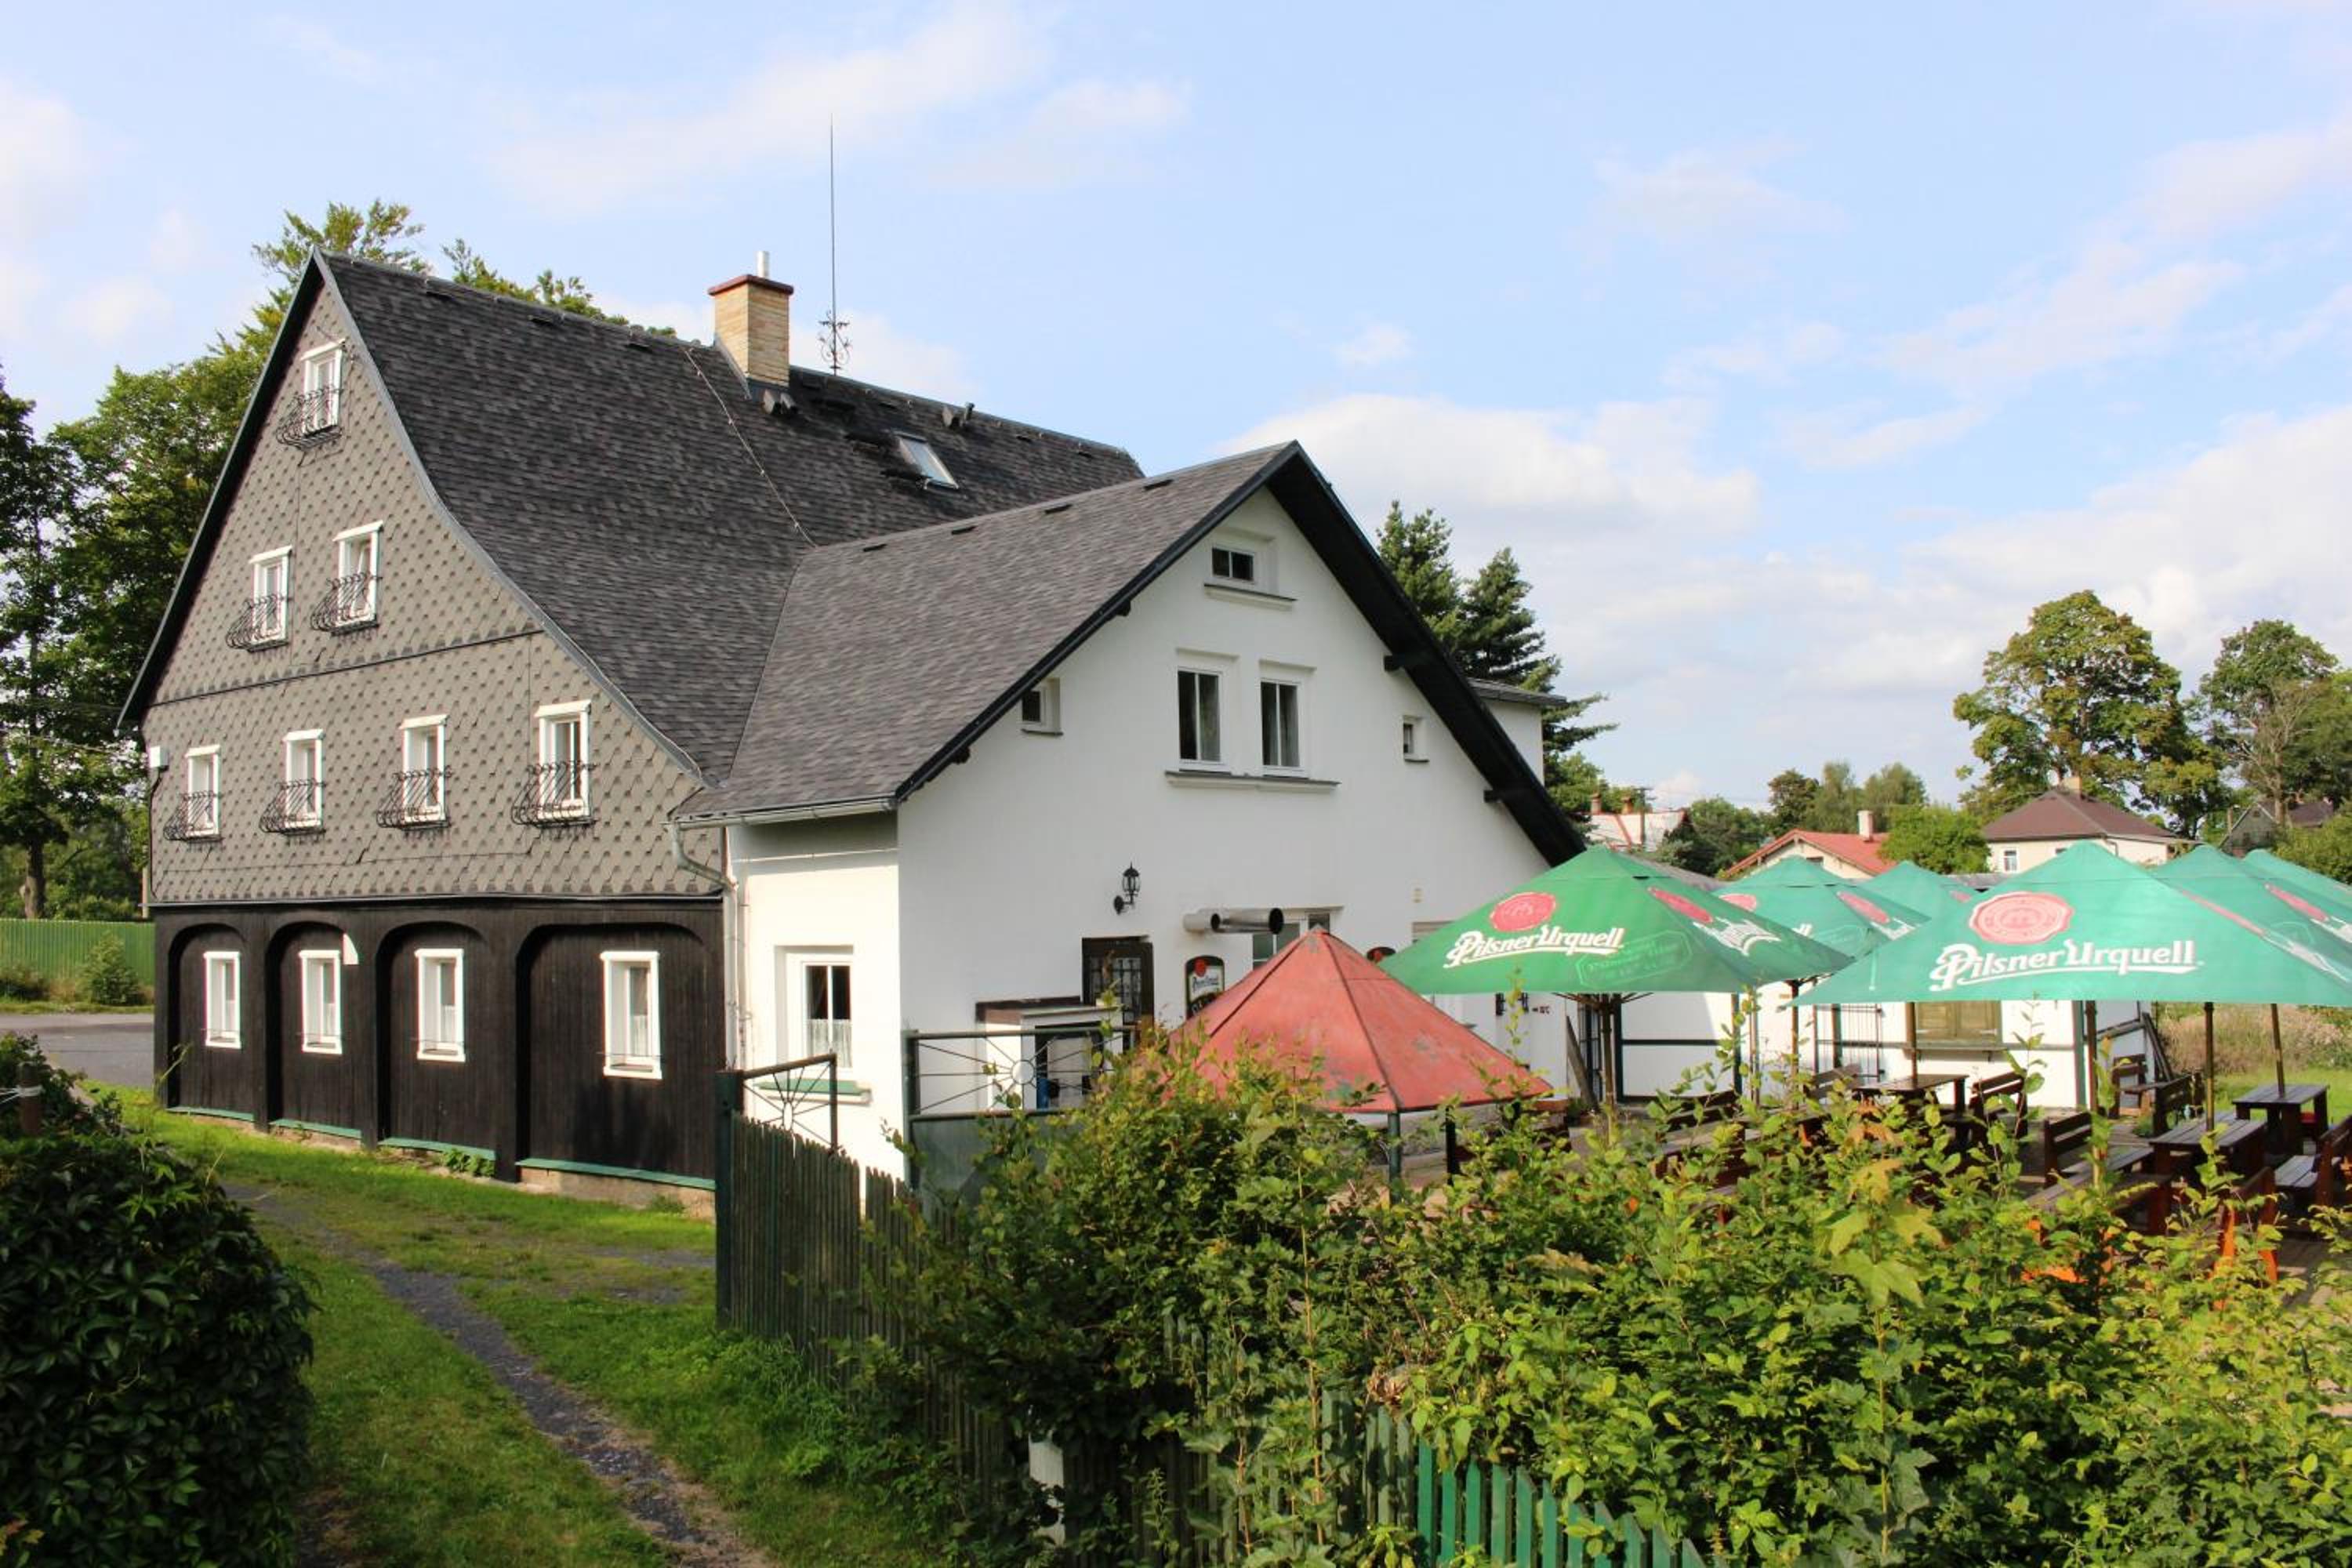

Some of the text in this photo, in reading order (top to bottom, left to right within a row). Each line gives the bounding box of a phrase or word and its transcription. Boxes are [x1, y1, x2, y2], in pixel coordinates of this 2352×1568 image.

[1443, 931, 1540, 969] Pilsner
[1540, 924, 1625, 956] Urquell
[1929, 938, 2198, 991] Pilsner Urquell
